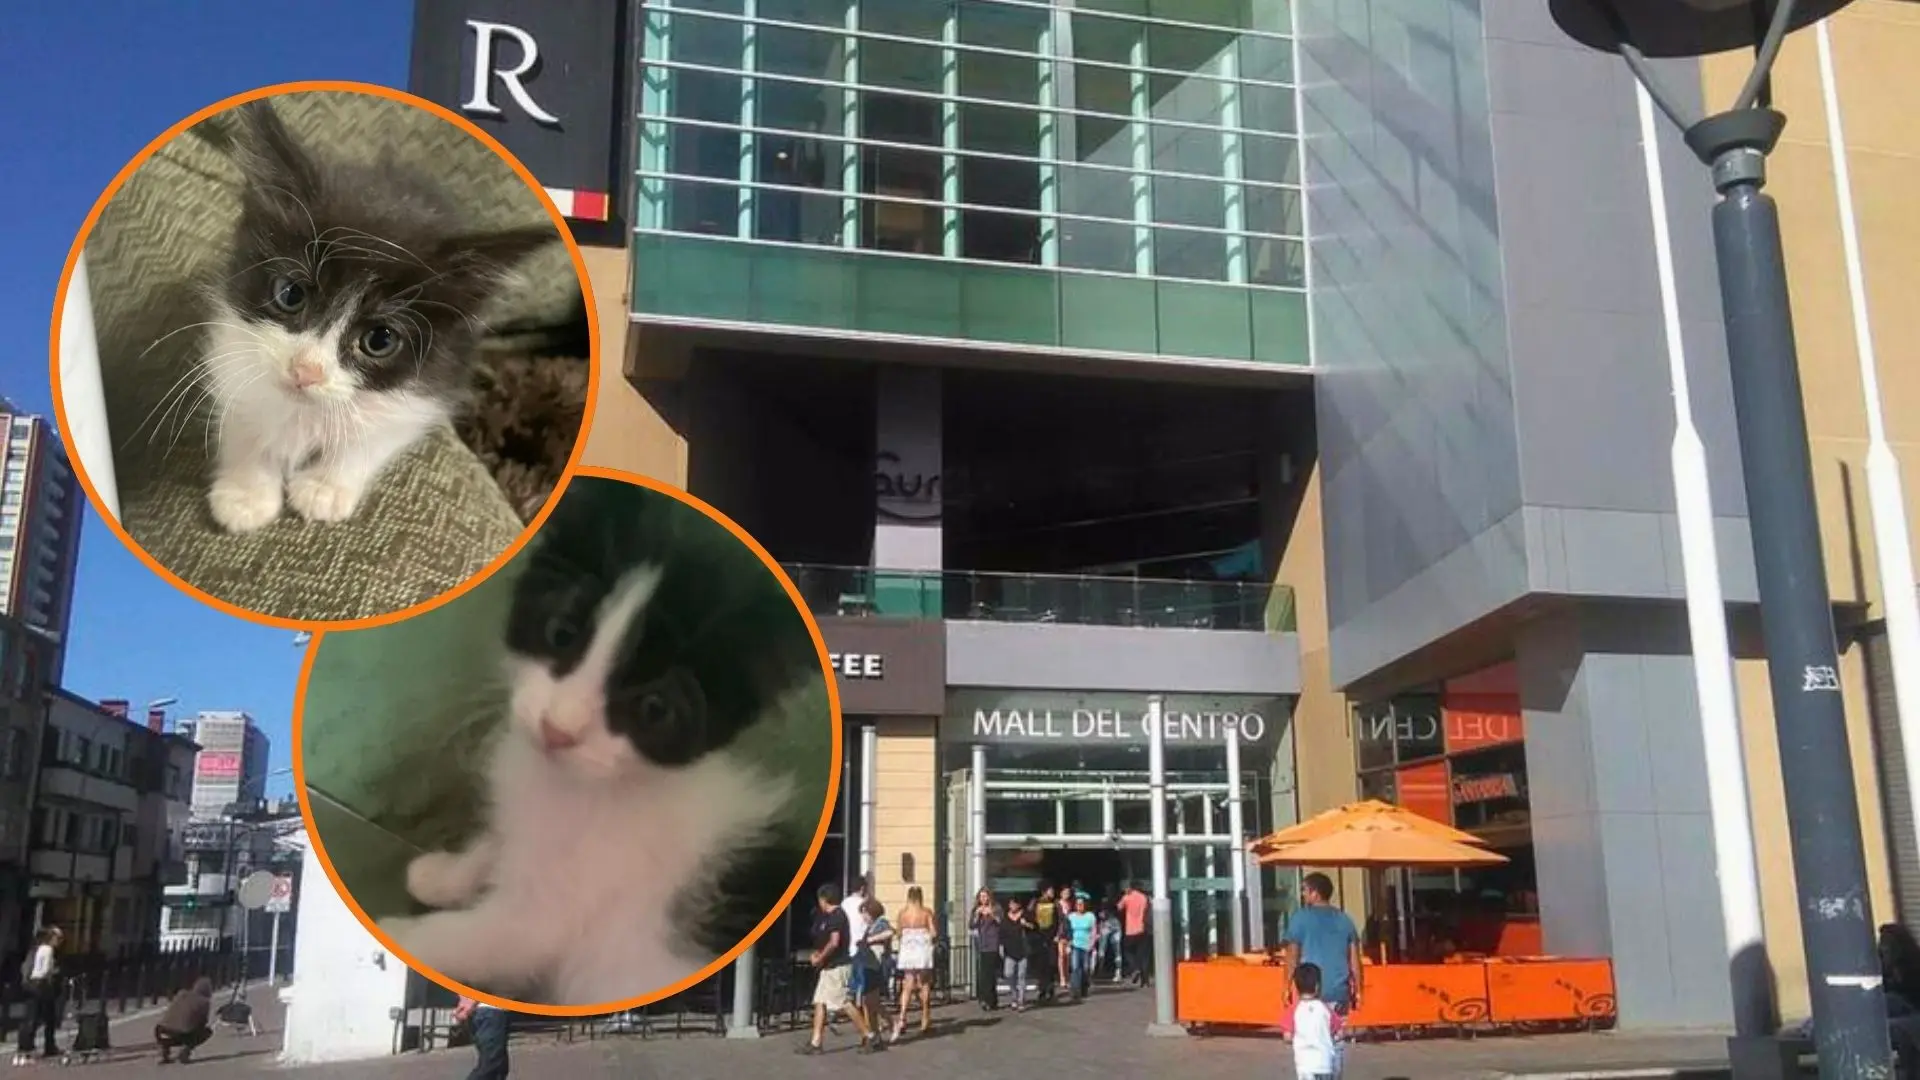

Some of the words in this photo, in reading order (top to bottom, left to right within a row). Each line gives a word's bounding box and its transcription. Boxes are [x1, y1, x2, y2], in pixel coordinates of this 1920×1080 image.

[461, 19, 559, 124] R
[973, 708, 1062, 737] MALL
[1072, 709, 1131, 738] DEL
